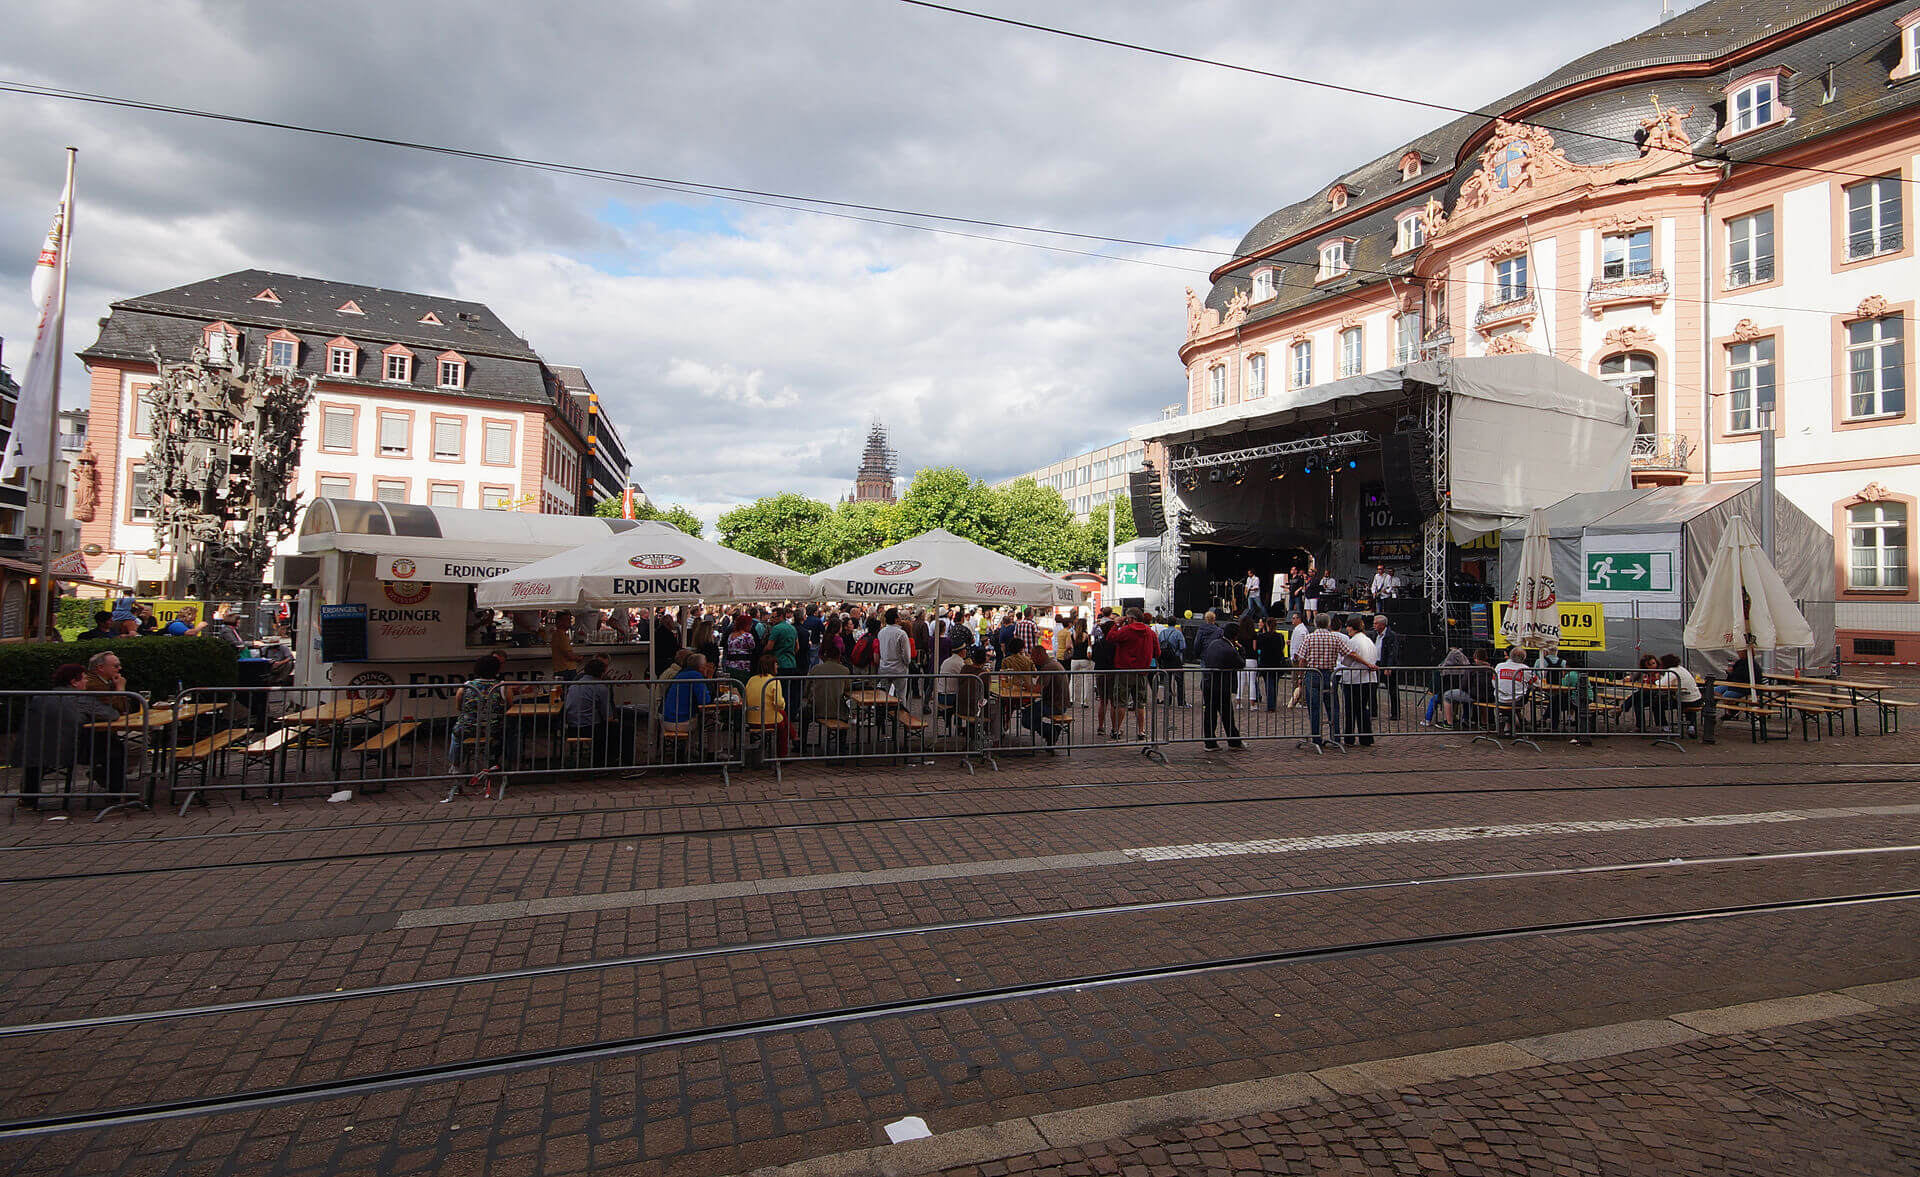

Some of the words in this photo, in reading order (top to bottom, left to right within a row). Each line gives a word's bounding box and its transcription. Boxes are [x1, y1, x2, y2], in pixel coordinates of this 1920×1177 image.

[613, 578, 701, 596] ERDINGER
[847, 580, 914, 596] ERDINGER
[369, 608, 440, 622] ERDINGER
[1561, 614, 1592, 628] 07.9
